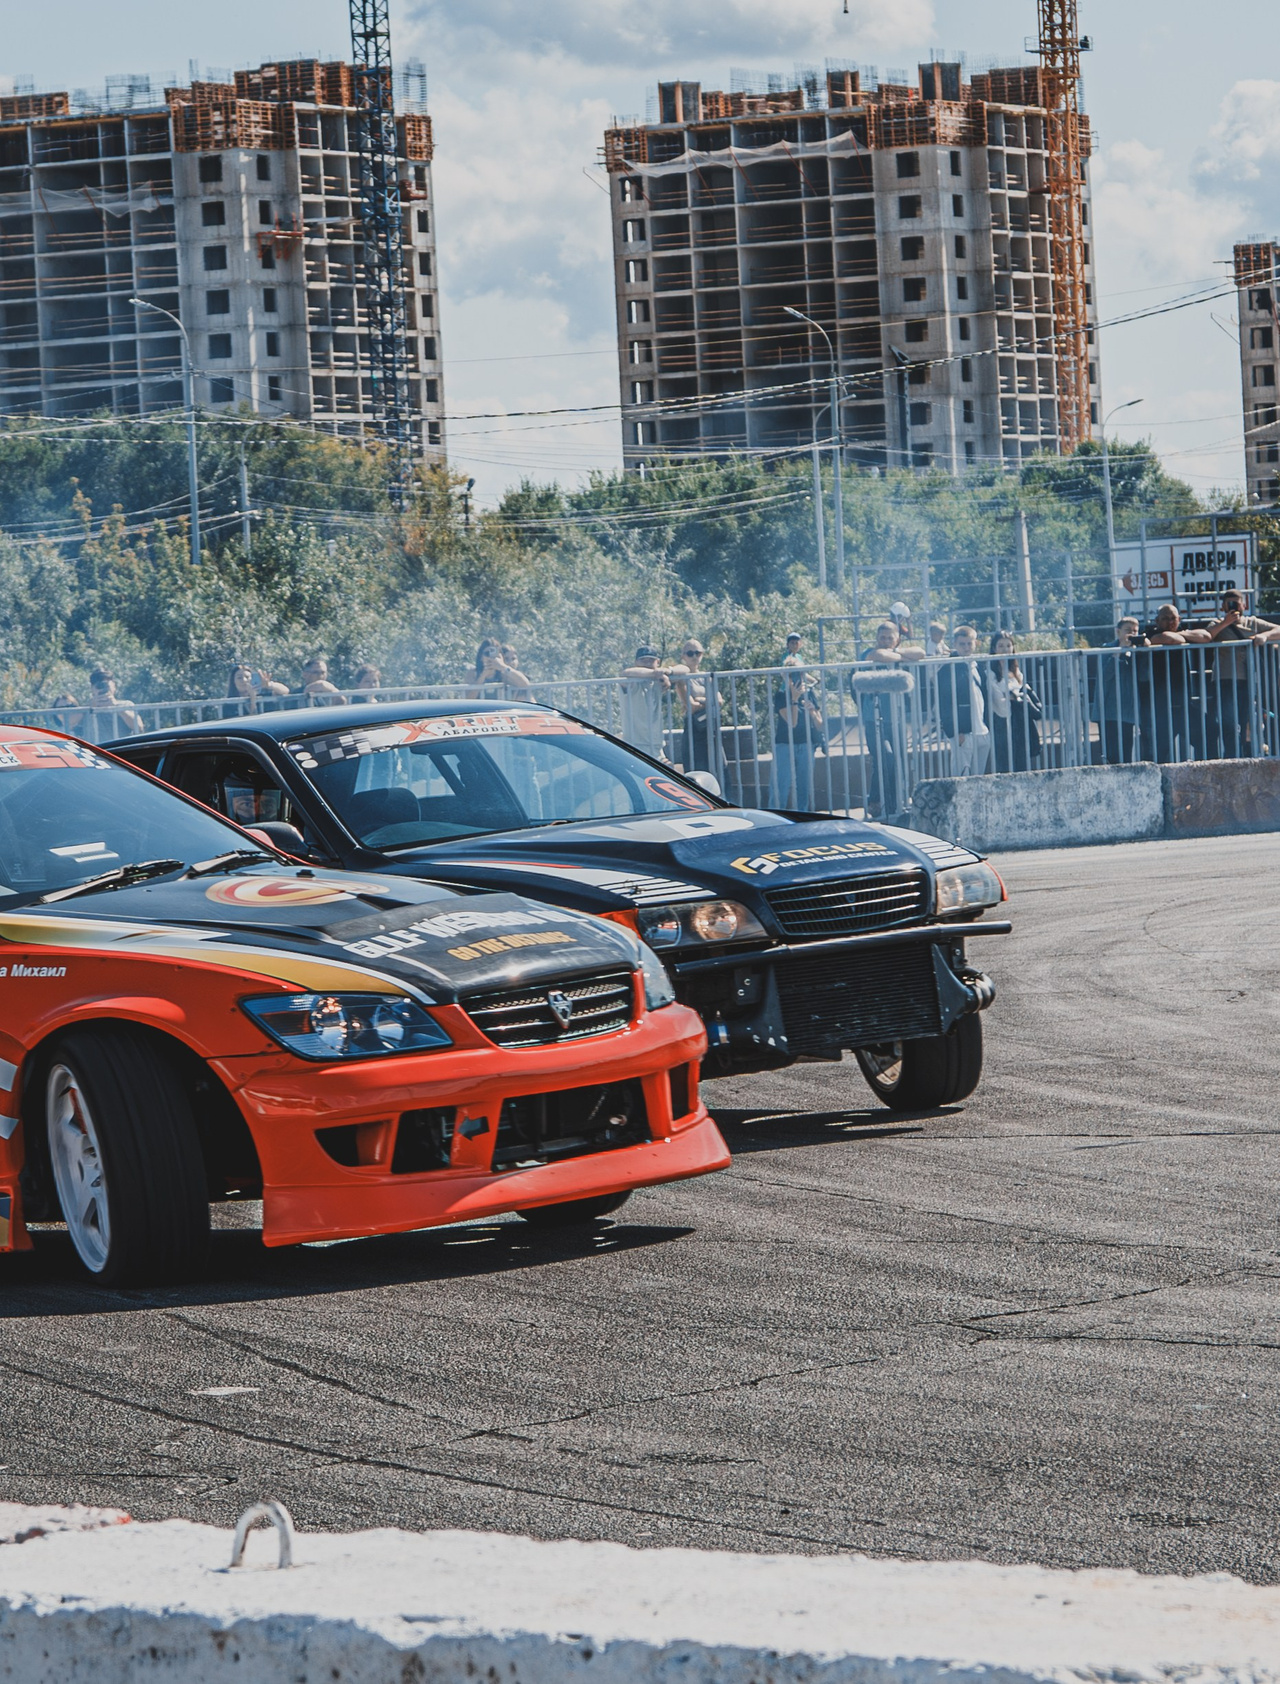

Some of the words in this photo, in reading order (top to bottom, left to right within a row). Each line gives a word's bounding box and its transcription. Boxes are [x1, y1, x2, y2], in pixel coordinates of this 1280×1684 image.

[1182, 551, 1237, 577] ДВЕРИ
[761, 842, 888, 862] FOCUS
[779, 854, 848, 868] DETAILING
[847, 850, 899, 859] CENTER
[343, 929, 427, 959] GULF
[447, 946, 482, 961] GO
[469, 938, 512, 954] THE
[10, 964, 67, 977] Михаил
